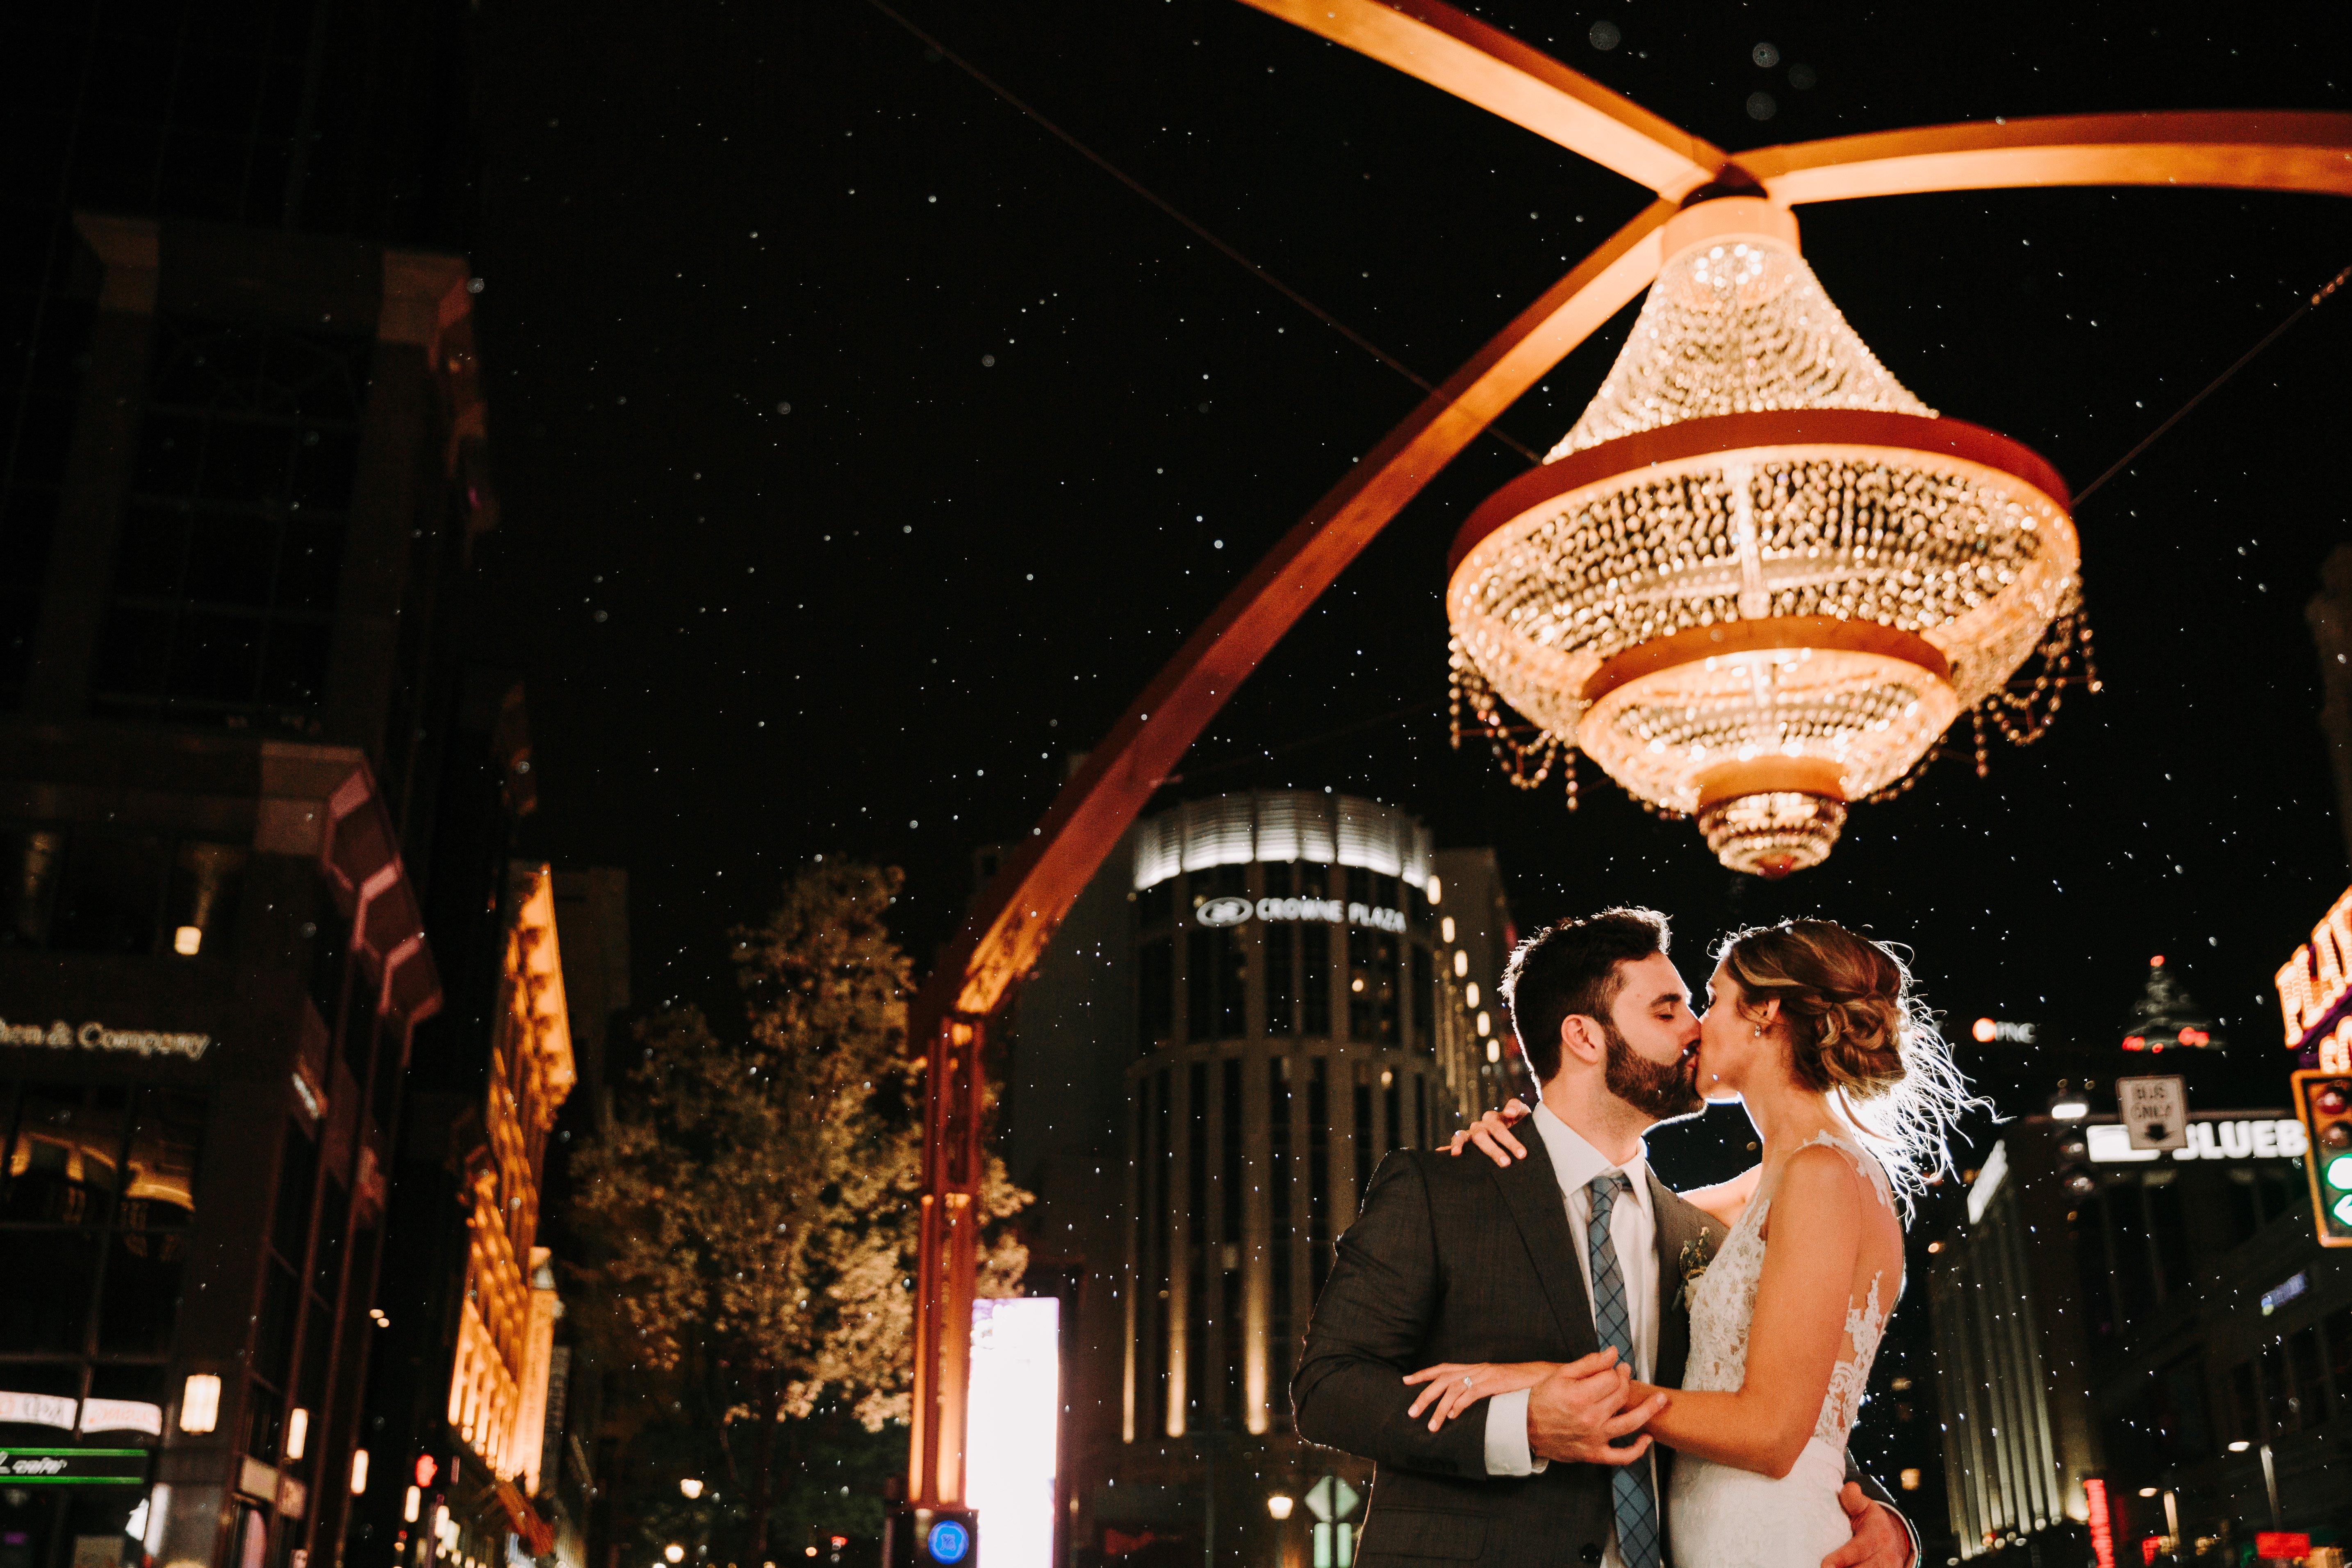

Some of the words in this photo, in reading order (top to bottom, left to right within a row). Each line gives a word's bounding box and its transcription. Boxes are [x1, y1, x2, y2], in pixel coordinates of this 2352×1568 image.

[1255, 898, 1344, 923] CROWNE
[1348, 902, 1407, 933] PLAZA
[77, 1021, 211, 1061] Company
[1995, 1021, 2036, 1044] PNC
[2133, 1083, 2168, 1100] BUS
[2132, 1103, 2174, 1119] ONLY
